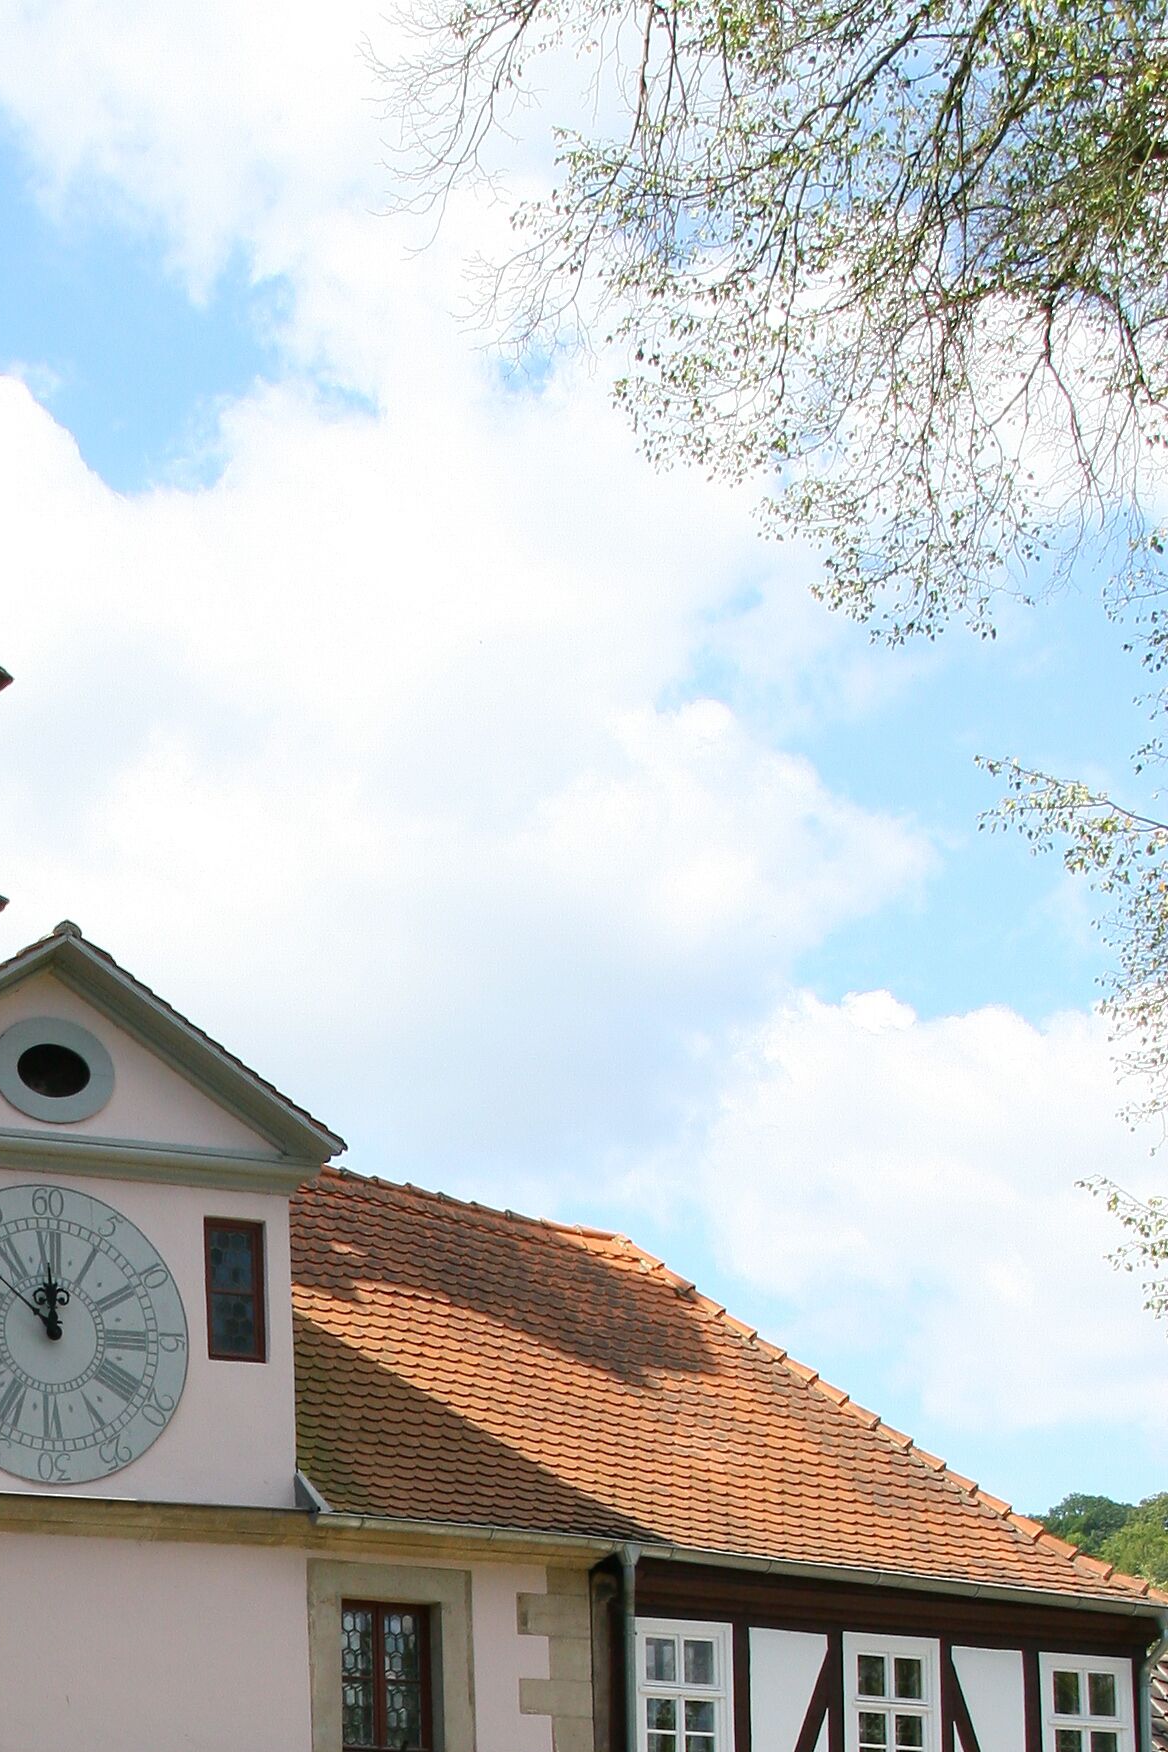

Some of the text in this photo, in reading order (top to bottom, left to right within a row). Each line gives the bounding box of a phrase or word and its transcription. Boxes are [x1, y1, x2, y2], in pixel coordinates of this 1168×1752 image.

[31, 1188, 64, 1218] 60
[98, 1215, 124, 1238] 5
[34, 1230, 62, 1278] XII
[138, 1262, 168, 1289] 10
[96, 1283, 136, 1312] II
[105, 1328, 149, 1351] III
[159, 1332, 186, 1353] 15
[93, 1357, 142, 1403] IIII
[43, 1392, 63, 1440] VI
[80, 1390, 106, 1431] V
[141, 1387, 175, 1427] 20
[37, 1452, 72, 1481] 30
[99, 1434, 132, 1471] 25
